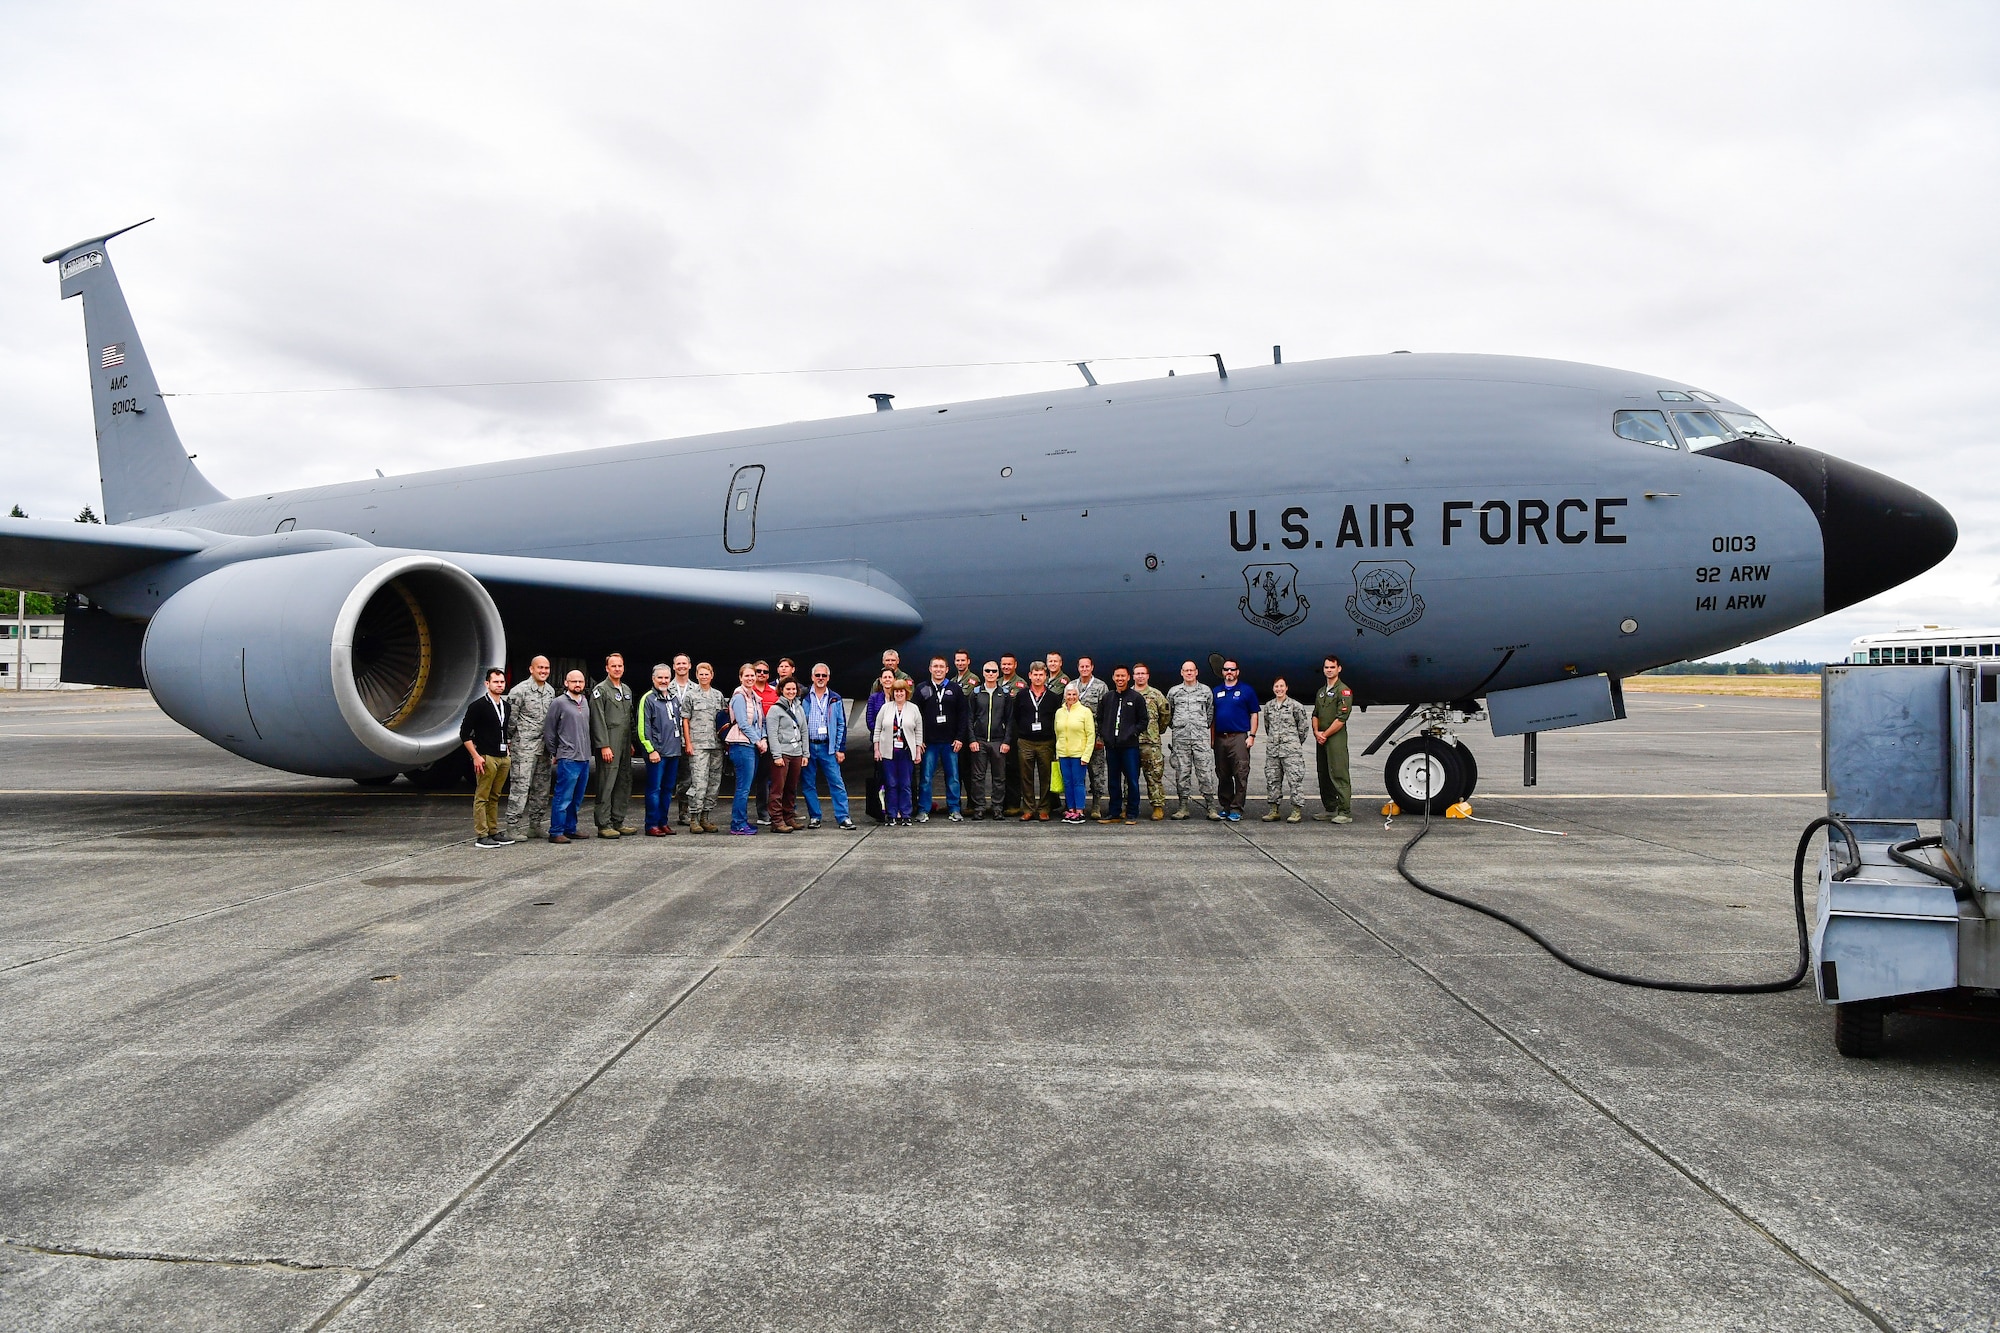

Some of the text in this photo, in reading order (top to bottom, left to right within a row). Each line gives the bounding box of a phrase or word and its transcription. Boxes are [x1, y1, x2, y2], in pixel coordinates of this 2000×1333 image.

[110, 375, 128, 391] AMC
[112, 398, 136, 415] 80103
[1230, 498, 1628, 551] U.S. AIR FORCE
[1713, 536, 1756, 553] 0103
[1696, 565, 1770, 583] 92 ARW
[1696, 594, 1766, 611] 141 ARW
[1393, 606, 1422, 629] COMMAND
